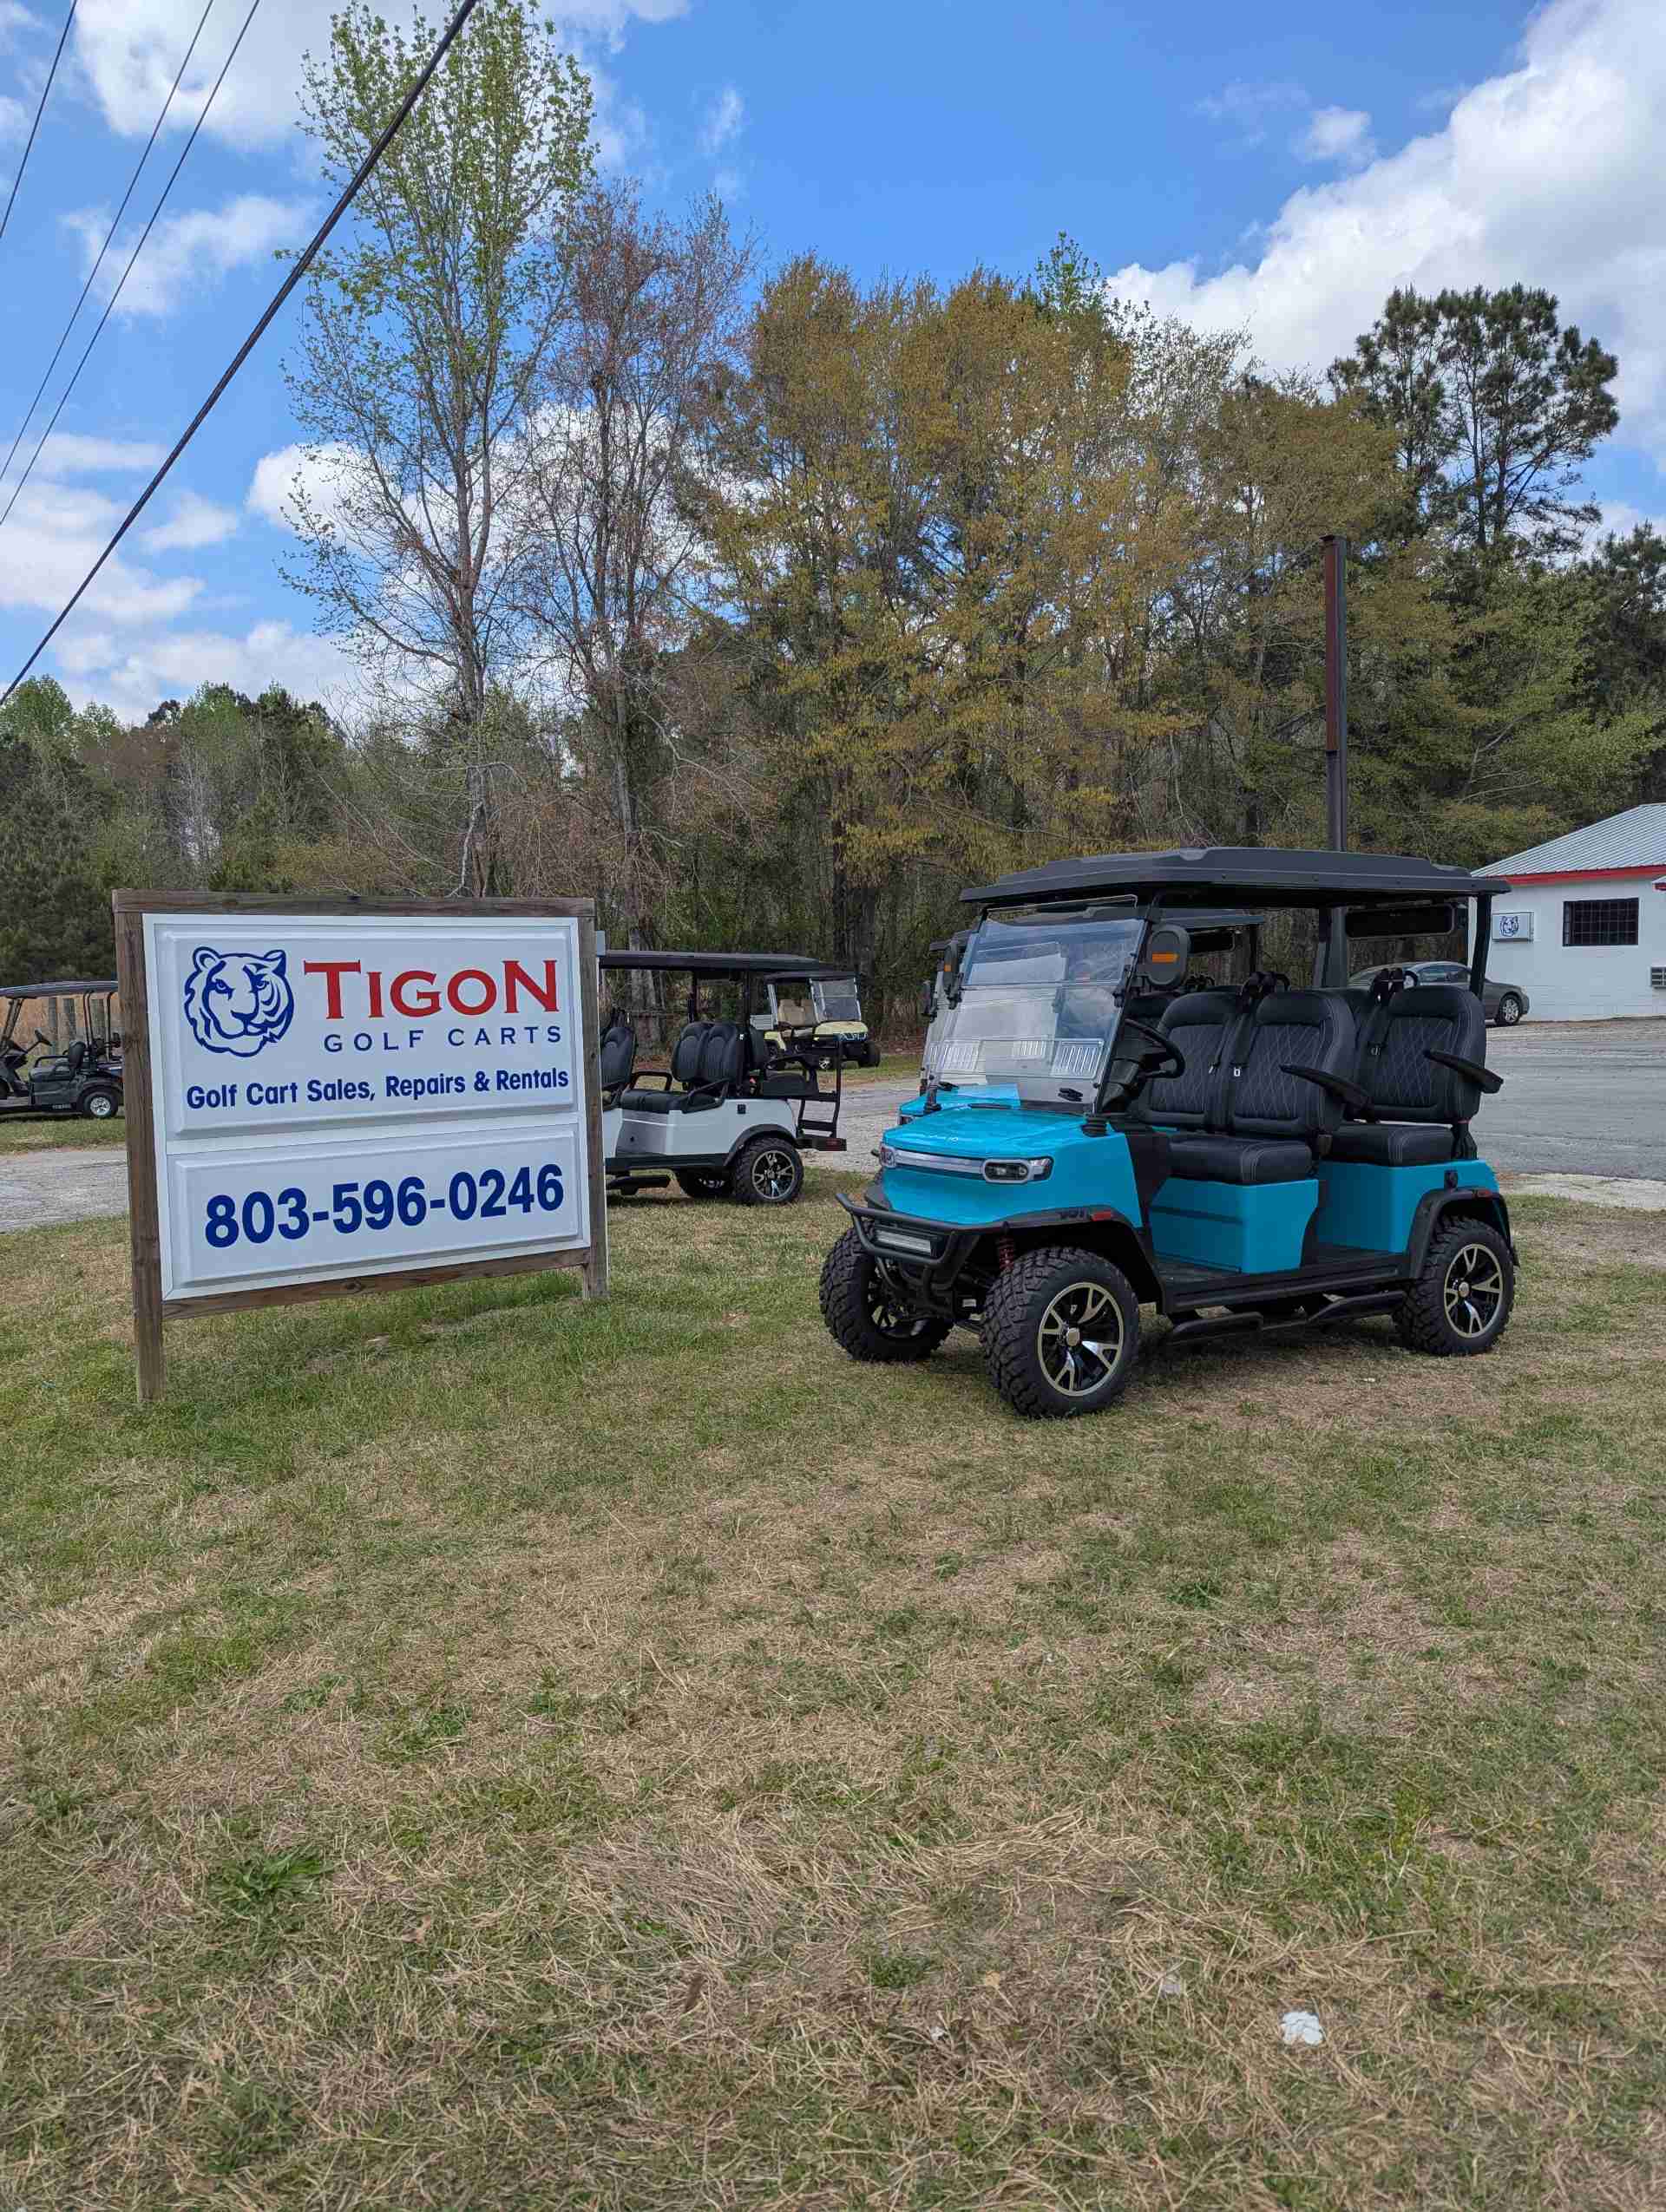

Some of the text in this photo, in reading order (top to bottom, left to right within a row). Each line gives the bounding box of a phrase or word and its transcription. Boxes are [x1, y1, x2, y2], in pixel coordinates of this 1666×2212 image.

[304, 959, 558, 1019] TIGON
[324, 1026, 561, 1052] GOLF CARTS
[187, 1068, 569, 1109] Golf Cart Sales, Repairs & Rentals
[205, 1163, 565, 1249] 803-596-0246
